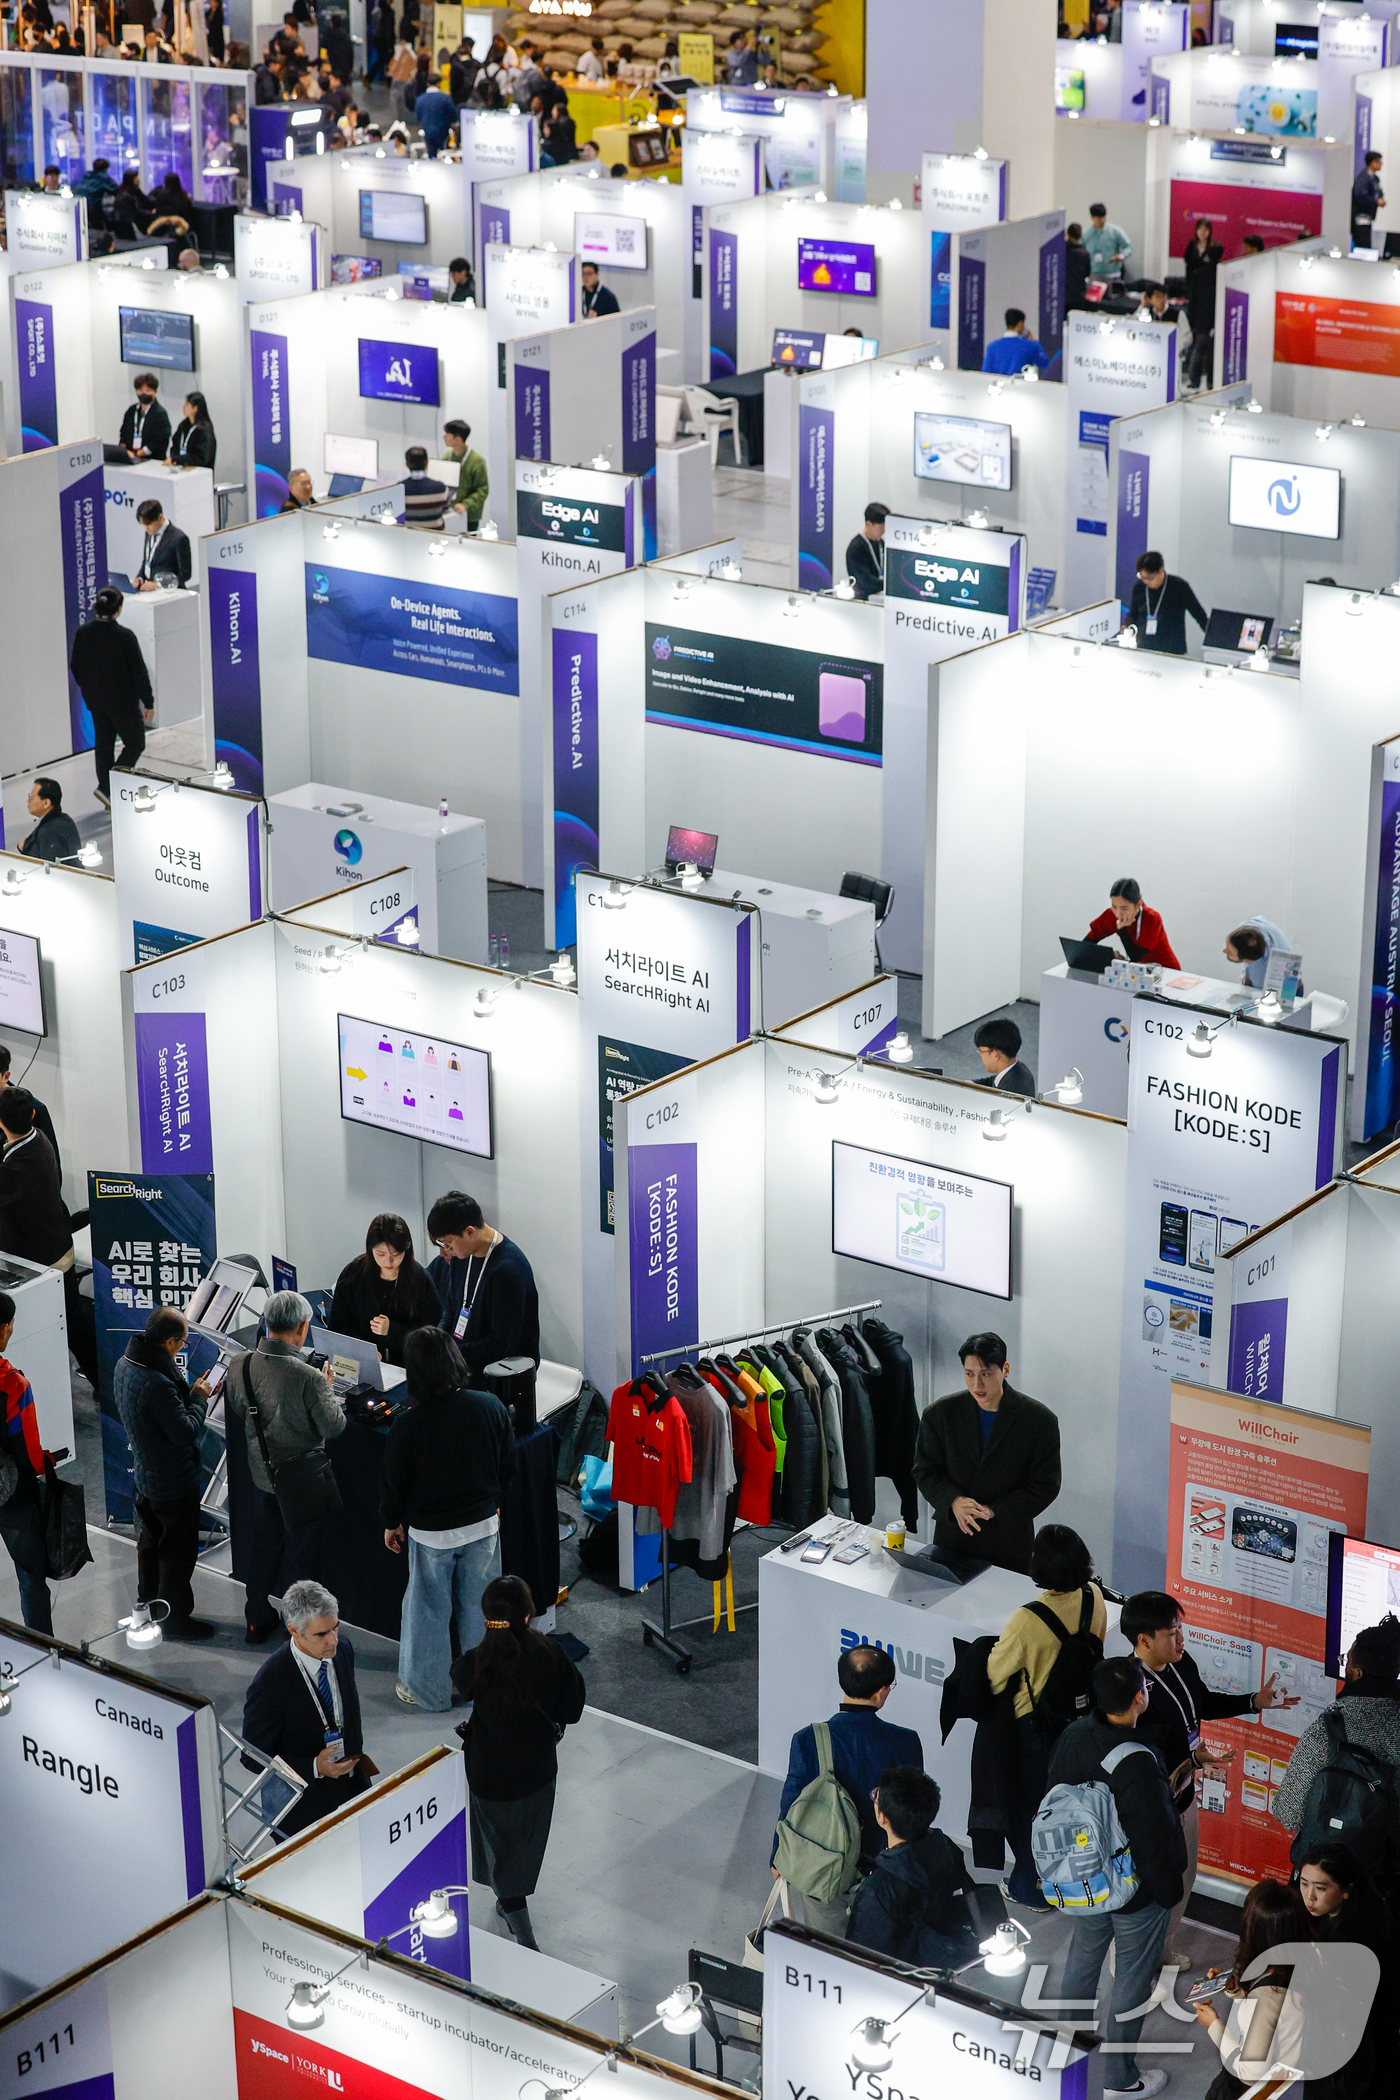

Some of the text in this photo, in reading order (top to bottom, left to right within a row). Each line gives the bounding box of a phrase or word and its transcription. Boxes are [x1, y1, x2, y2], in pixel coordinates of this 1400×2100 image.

[69, 453, 92, 468] C130
[541, 500, 599, 524] Edge AI
[220, 542, 244, 559] C115
[541, 550, 601, 574] Kihon.AI
[709, 555, 731, 572] C119
[914, 559, 980, 585] Edge AI
[390, 596, 462, 621] On-Device Agents.
[563, 602, 587, 620] C114
[228, 592, 242, 665] Kihon.AI
[411, 615, 496, 643] Real Life Interactions.
[895, 611, 997, 641] Predictive.AI
[1089, 619, 1110, 638] C118
[569, 653, 584, 770] Predictive.AI
[160, 844, 201, 871] 아웃컴
[155, 868, 210, 892] Outcome
[336, 865, 363, 881] Kihon
[370, 892, 401, 915] C108
[294, 944, 312, 957] Seed
[604, 948, 709, 989] 서치라이트 AI
[1386, 925, 1397, 1005] AUSTRIA
[152, 974, 186, 998] C103
[604, 974, 710, 1013] SearcHRight AI
[853, 1003, 882, 1031] C107
[1144, 1019, 1184, 1042] C102
[1382, 1007, 1393, 1068] SEOUL
[172, 1041, 192, 1152] 서치라이트 AI
[606, 1077, 617, 1088] AI
[787, 1065, 814, 1082] Pre-A,
[858, 1083, 887, 1100] Energy
[888, 1091, 895, 1101] &
[896, 1093, 954, 1117] Sustainability
[158, 1047, 174, 1154] SearcHRight AI
[1146, 1075, 1302, 1130] FASHION KODE
[646, 1102, 679, 1130] C102
[934, 1120, 957, 1135] 솔루션
[1174, 1109, 1271, 1154] [KODE:S]
[868, 1161, 974, 1198] 친환경적 영향을 보여주는
[647, 1180, 663, 1277] [KODE:S]
[107, 1240, 202, 1264] AI로 찾는
[665, 1173, 679, 1322] FASHION KODE
[111, 1264, 202, 1288] 우리 회사
[1247, 1254, 1276, 1286] C101
[111, 1286, 154, 1310] 핵심
[1255, 1332, 1271, 1396] 윌체어
[1238, 1418, 1299, 1445] WillChair
[1190, 1436, 1277, 1467] 무장애 도시 환경 구축 솔루션
[1183, 1586, 1233, 1606] 주요 서비스 소개
[1188, 1629, 1252, 1653] WillChair SaaS
[95, 1698, 165, 1741] Canada
[22, 1734, 120, 1799] Rangle
[389, 1797, 439, 1845] B116
[1229, 1861, 1256, 1875] WillChair
[262, 1941, 335, 1981] Professional
[337, 1978, 386, 2005] services
[397, 2001, 442, 2031] startup
[785, 1965, 842, 2005] B111
[263, 1965, 287, 1985] Your
[338, 1999, 366, 2019] Grow
[367, 2012, 410, 2040] Globally
[17, 2023, 75, 2077] B111
[952, 2032, 1042, 2083] Canada
[297, 2056, 327, 2077] YORK
